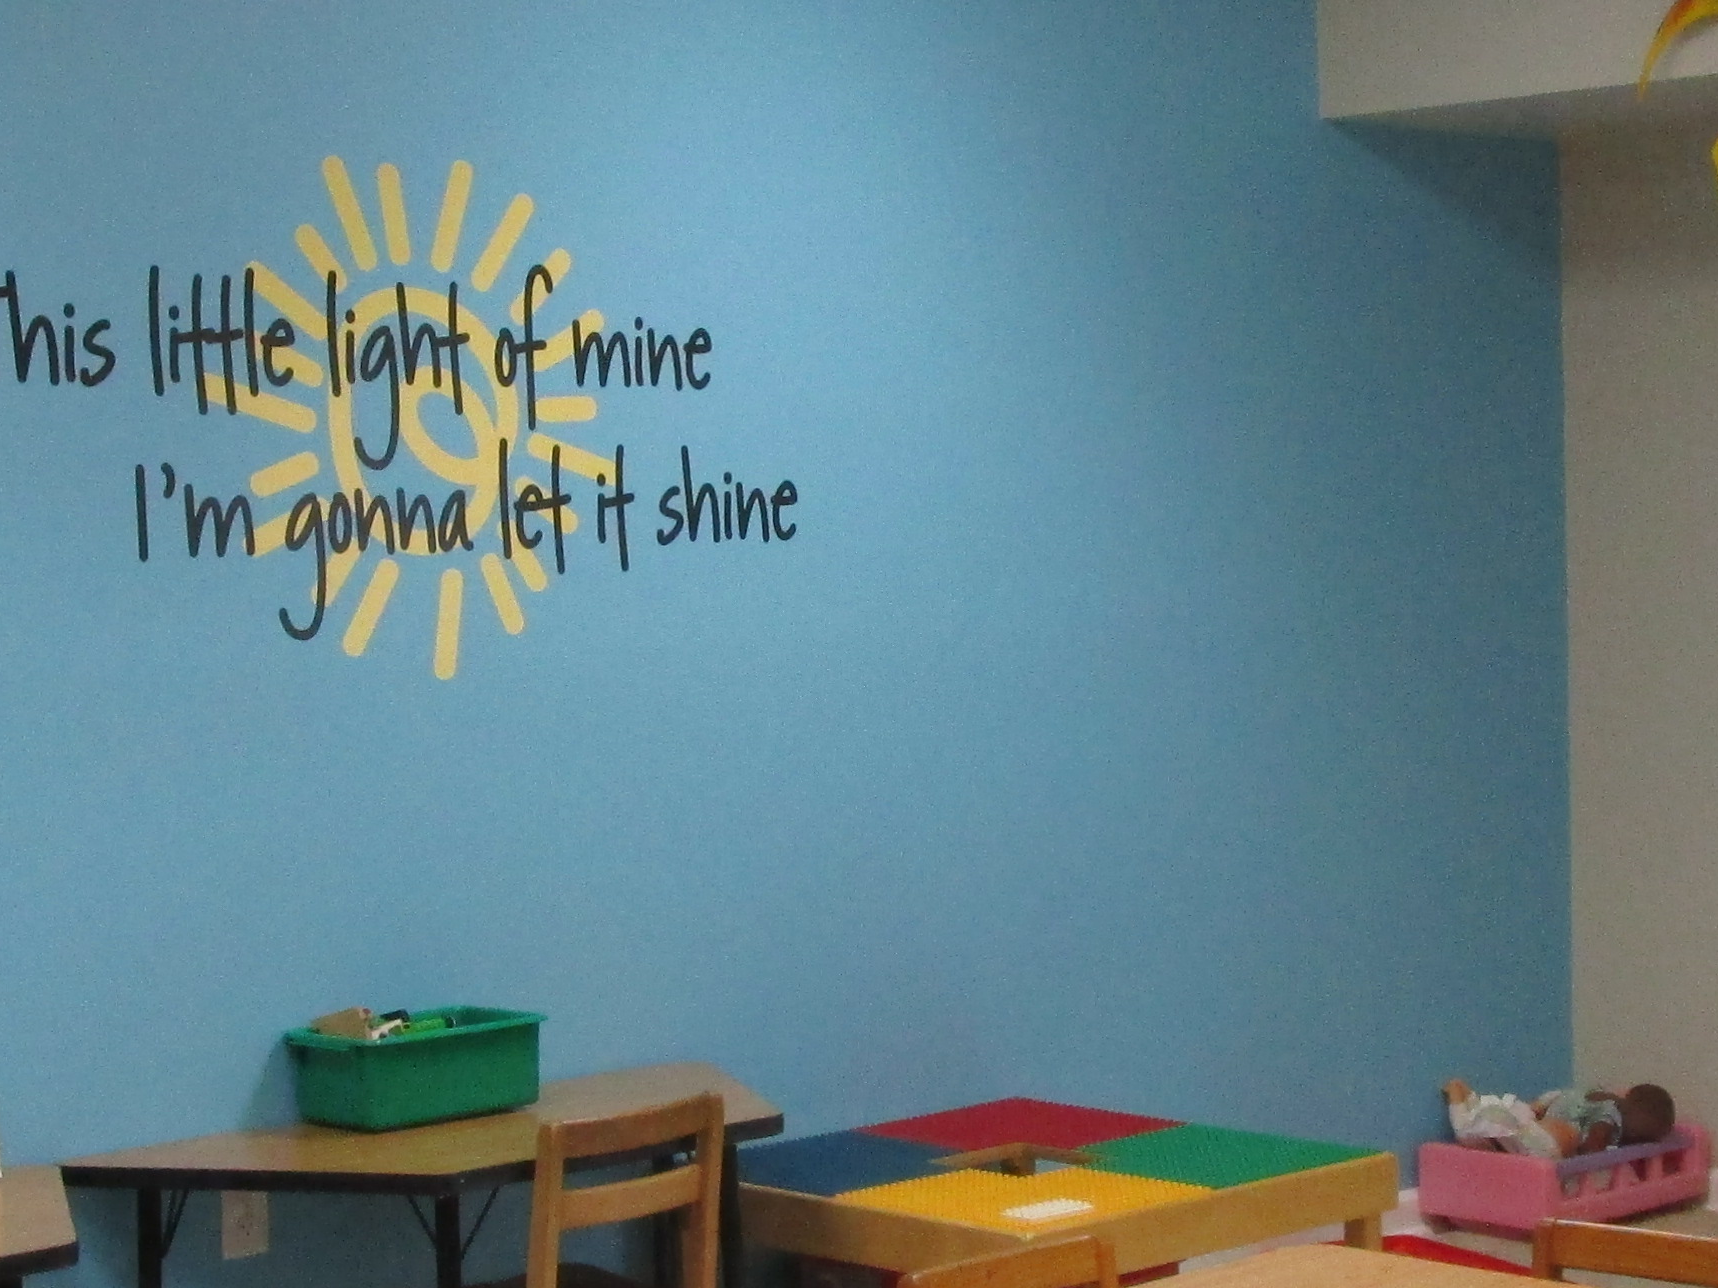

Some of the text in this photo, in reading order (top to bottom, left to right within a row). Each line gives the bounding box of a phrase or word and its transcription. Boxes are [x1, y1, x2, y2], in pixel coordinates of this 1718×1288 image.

[148, 266, 296, 415] little
[327, 270, 470, 469] light
[494, 265, 553, 430] of
[572, 316, 713, 390] mine
[134, 438, 799, 641] I'm gonna let it shine
